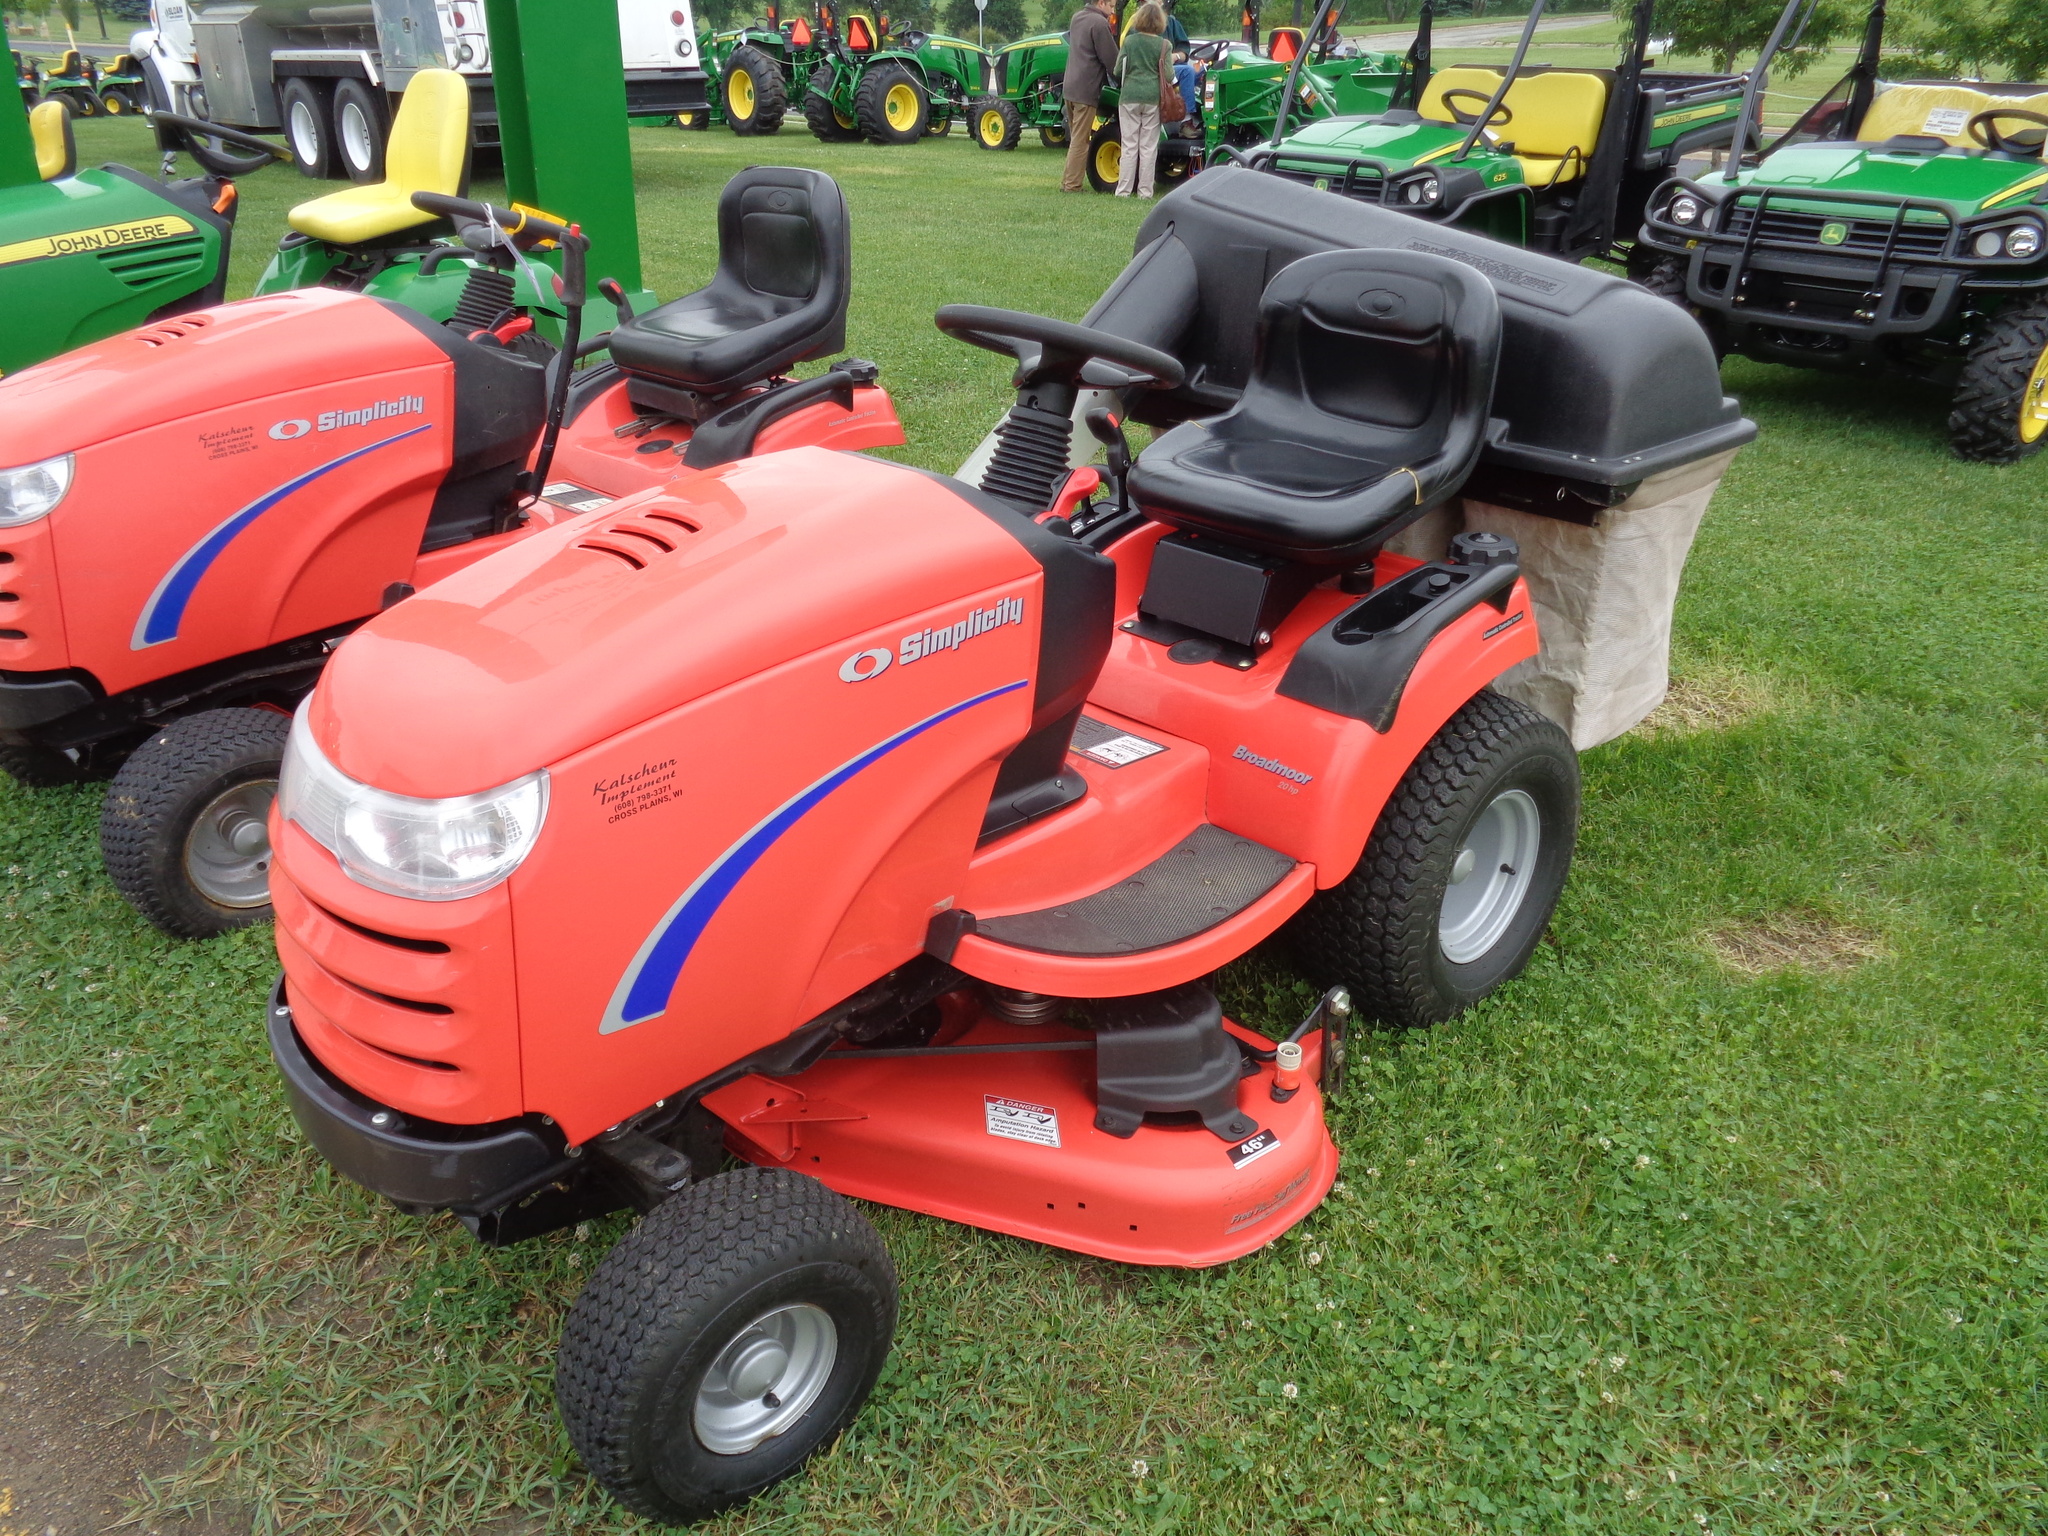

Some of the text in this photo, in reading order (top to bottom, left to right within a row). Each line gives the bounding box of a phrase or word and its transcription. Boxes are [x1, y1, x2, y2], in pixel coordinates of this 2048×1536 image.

[47, 223, 168, 254] JOHN DEERE
[317, 395, 424, 432] Simplicity
[899, 597, 1024, 666] Simplicity
[592, 758, 677, 796] Kalscheur
[1232, 744, 1313, 785] Broadmoor
[601, 770, 676, 805] Implement
[614, 784, 671, 813] (608) 798-3371
[1278, 781, 1298, 795] 20 hp
[608, 789, 683, 824] CROSS PLAINS, WI
[1006, 1101, 1044, 1113] DANGER
[991, 1117, 1054, 1134] Amputation Hazard
[1241, 1134, 1266, 1155] 46"
[1230, 1210, 1253, 1224] Free
